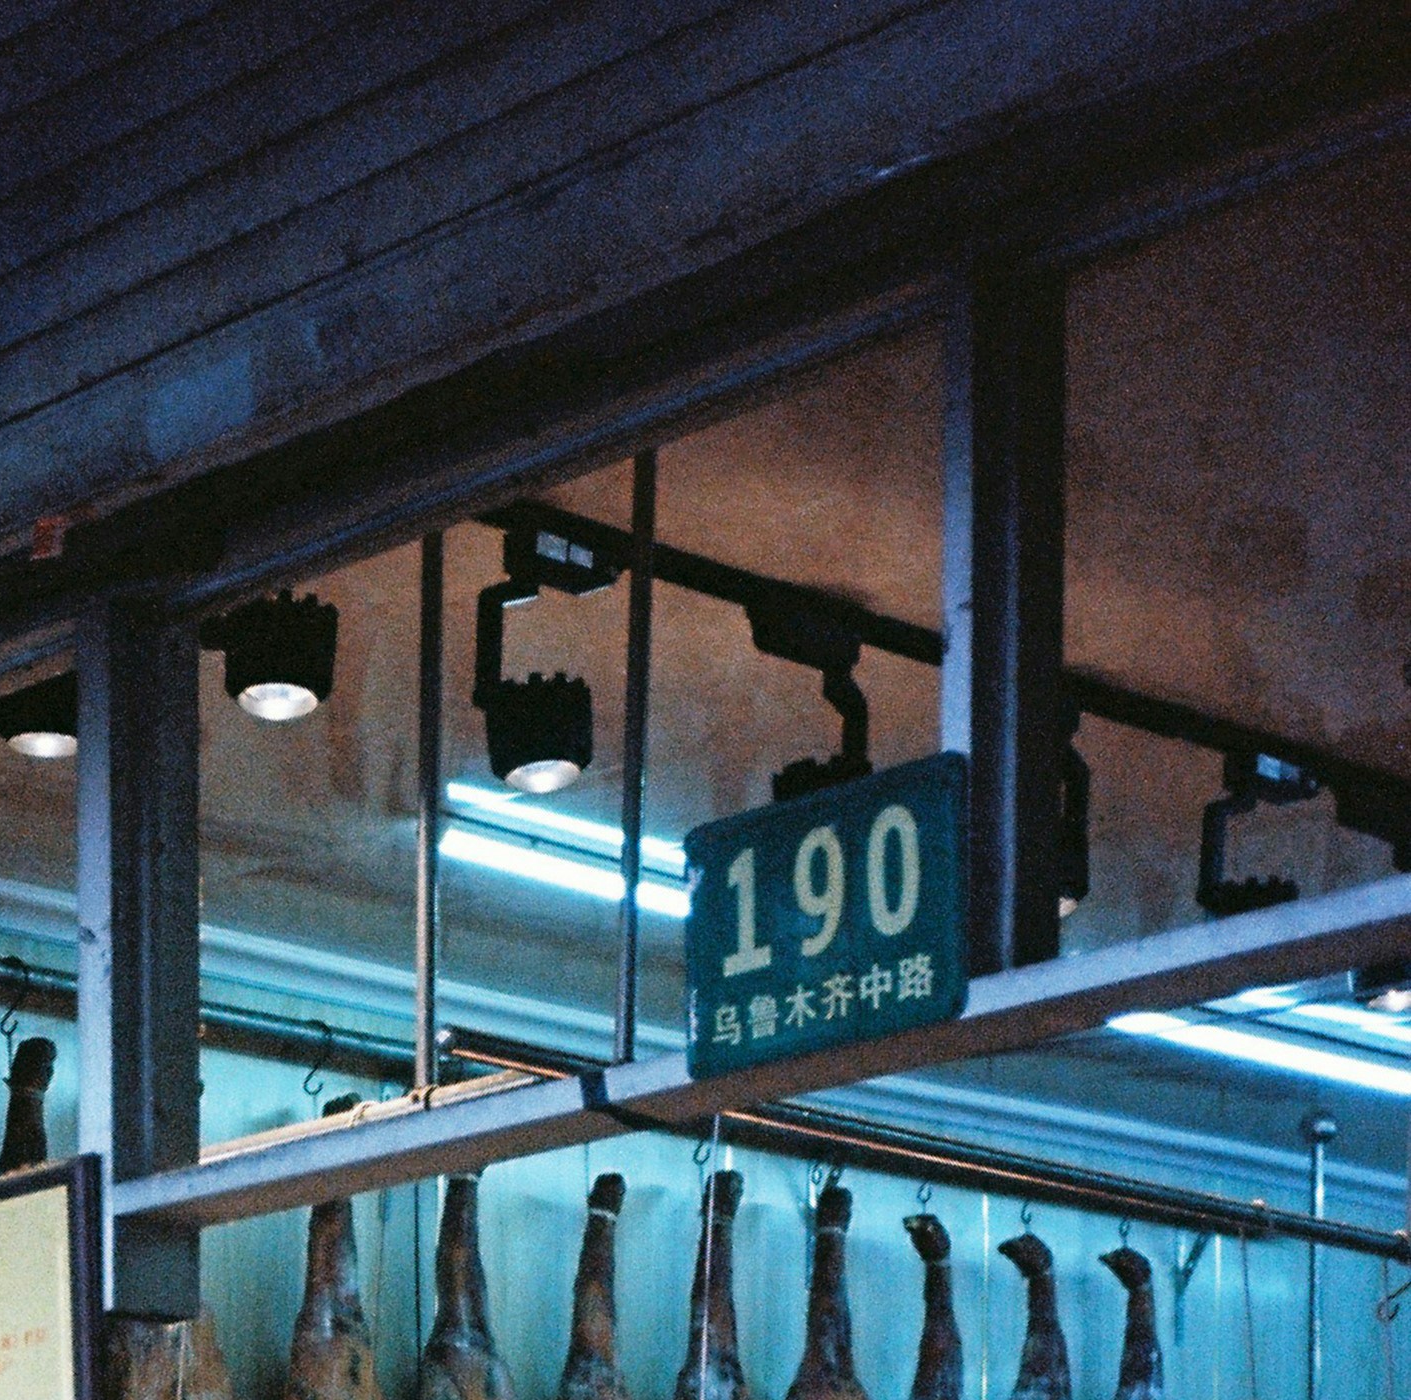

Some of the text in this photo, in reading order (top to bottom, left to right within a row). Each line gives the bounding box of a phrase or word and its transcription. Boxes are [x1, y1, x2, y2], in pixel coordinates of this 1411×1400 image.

[722, 804, 921, 978] 190
[711, 954, 934, 1046] 乌鲁木齐中路
